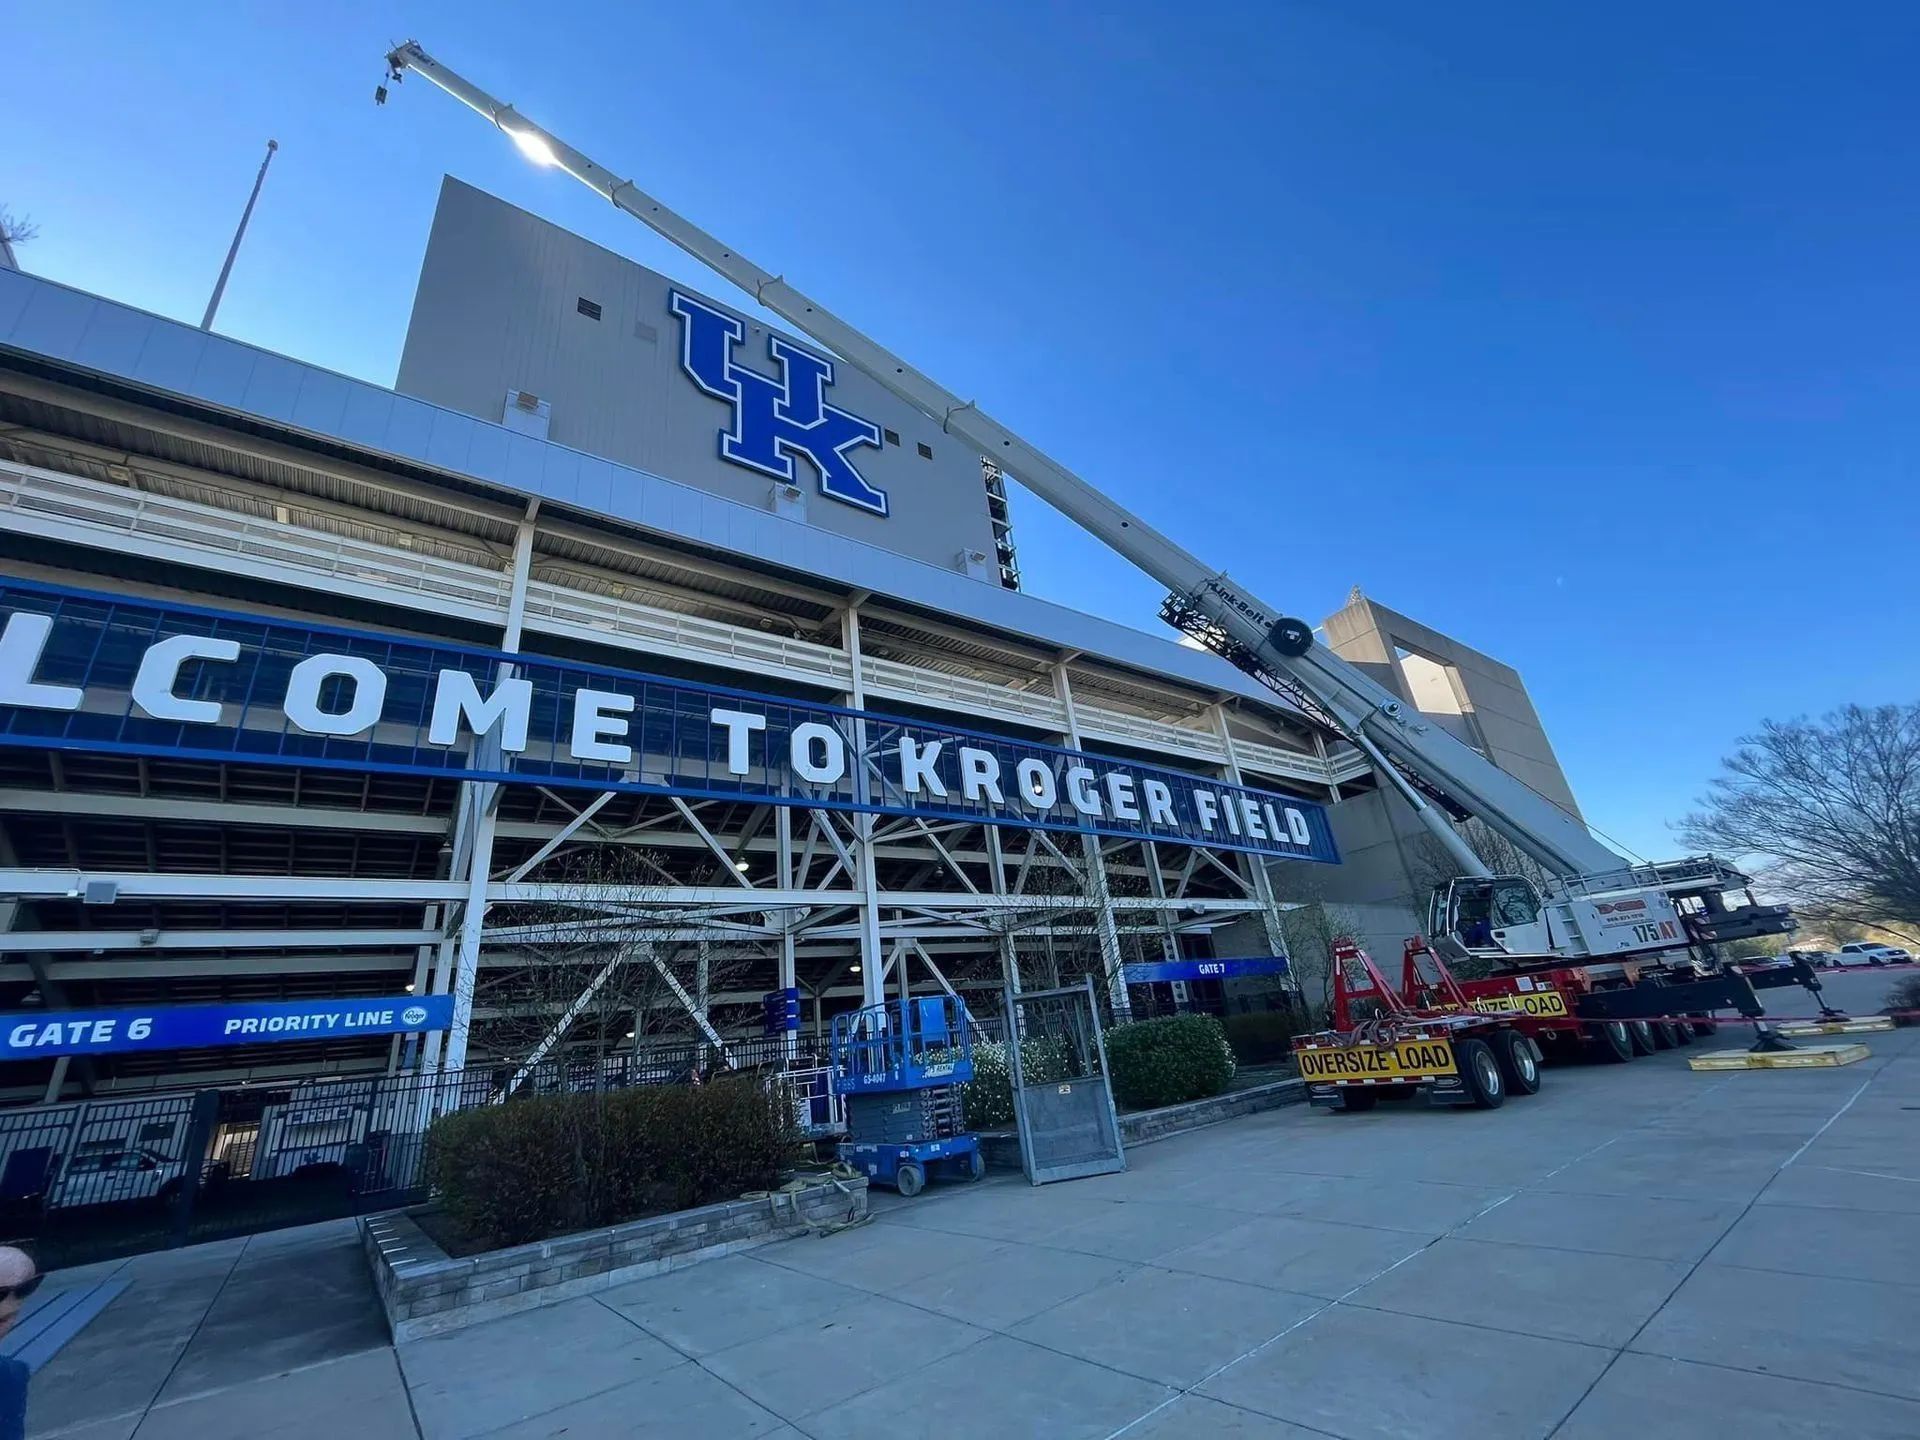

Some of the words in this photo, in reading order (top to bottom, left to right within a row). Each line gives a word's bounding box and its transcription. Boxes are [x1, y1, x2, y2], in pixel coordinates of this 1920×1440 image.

[669, 288, 889, 517] UK
[711, 708, 845, 784] TO
[900, 736, 1178, 826] KROGER
[1193, 788, 1311, 846] FIELD
[1632, 923, 1660, 943] 175
[1199, 963, 1219, 975] GATE
[1218, 963, 1225, 973] 7
[8, 1019, 117, 1047] GATE
[127, 1018, 152, 1040] 6
[224, 1013, 340, 1035] PRIORITY
[345, 1010, 394, 1027] LINE
[1302, 1049, 1390, 1075] OVERSIZE
[1395, 1045, 1450, 1070] LOAD
